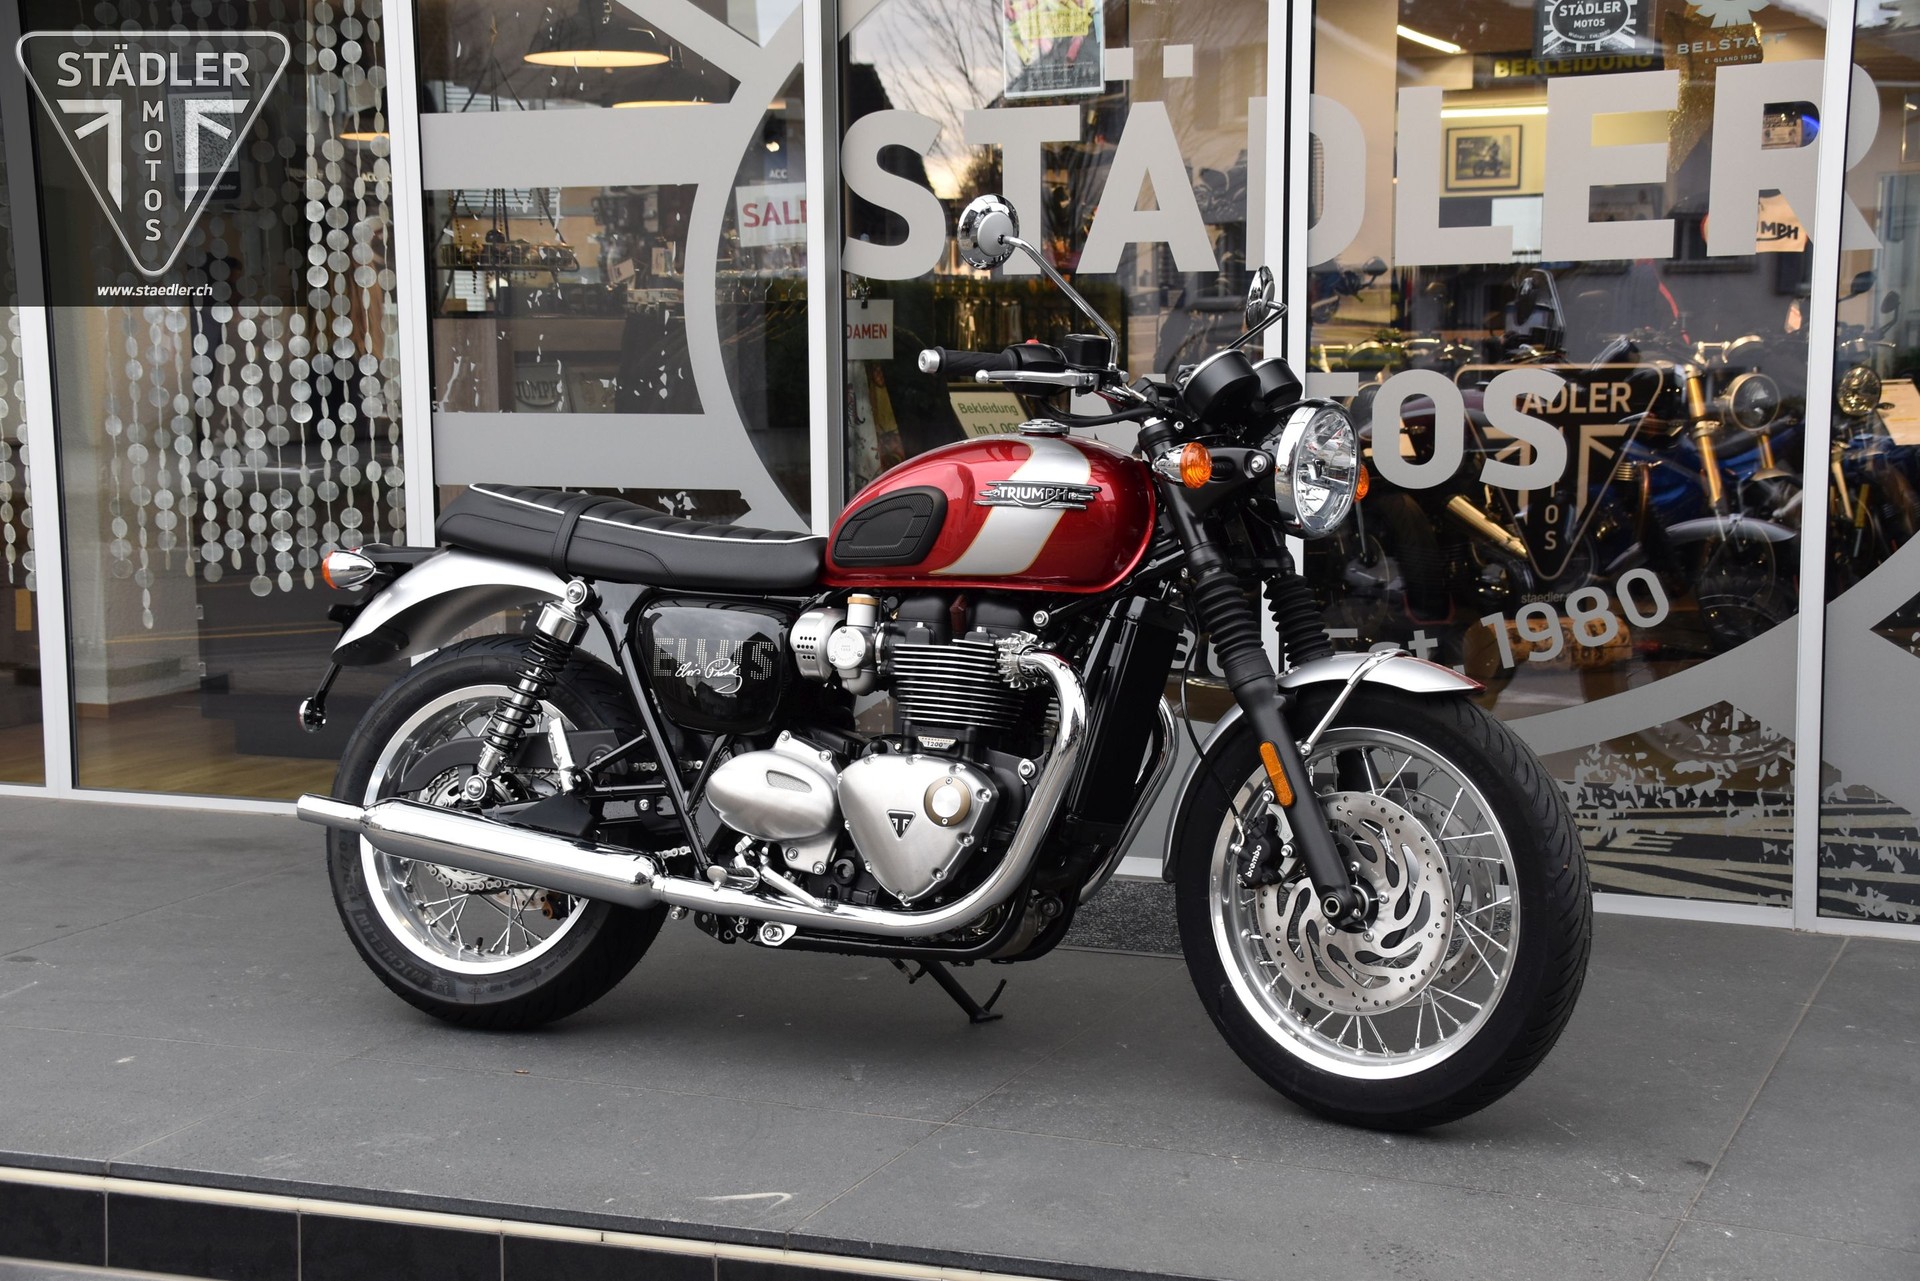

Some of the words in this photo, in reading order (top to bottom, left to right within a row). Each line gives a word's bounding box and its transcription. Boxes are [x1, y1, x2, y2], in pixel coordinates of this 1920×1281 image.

[1559, 0, 1621, 17] STÄDLER
[1573, 18, 1605, 28] MOTOS
[1677, 33, 1787, 55] BELSTAFF
[1494, 54, 1652, 78] BEKLEIDUNG
[958, 403, 1019, 416] Bekleidung
[998, 485, 1068, 502] TRIUMPH
[1481, 567, 1669, 669] 1980
[653, 637, 774, 680] ELVIS
[1245, 844, 1262, 878] brembo
